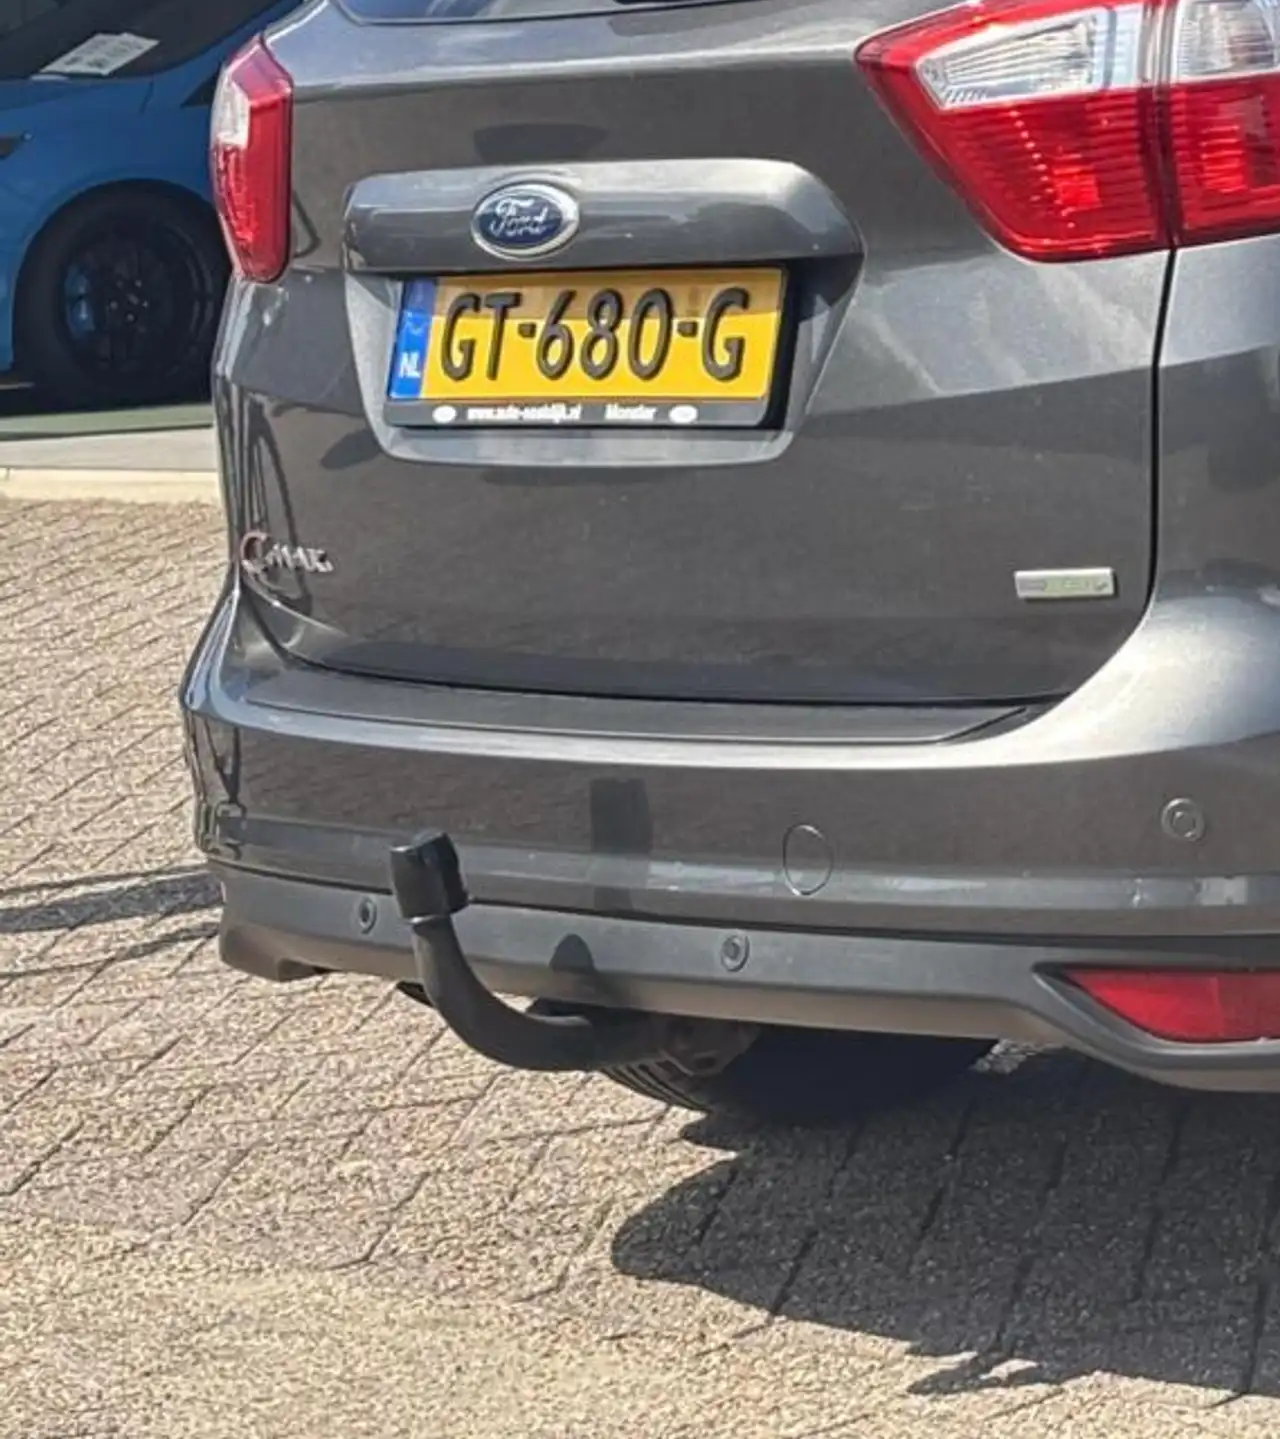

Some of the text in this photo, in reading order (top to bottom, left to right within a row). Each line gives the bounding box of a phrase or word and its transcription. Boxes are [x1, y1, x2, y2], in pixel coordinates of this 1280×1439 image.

[489, 197, 549, 238] Ford
[440, 285, 750, 383] GT-680-G
[399, 351, 421, 379] NL
